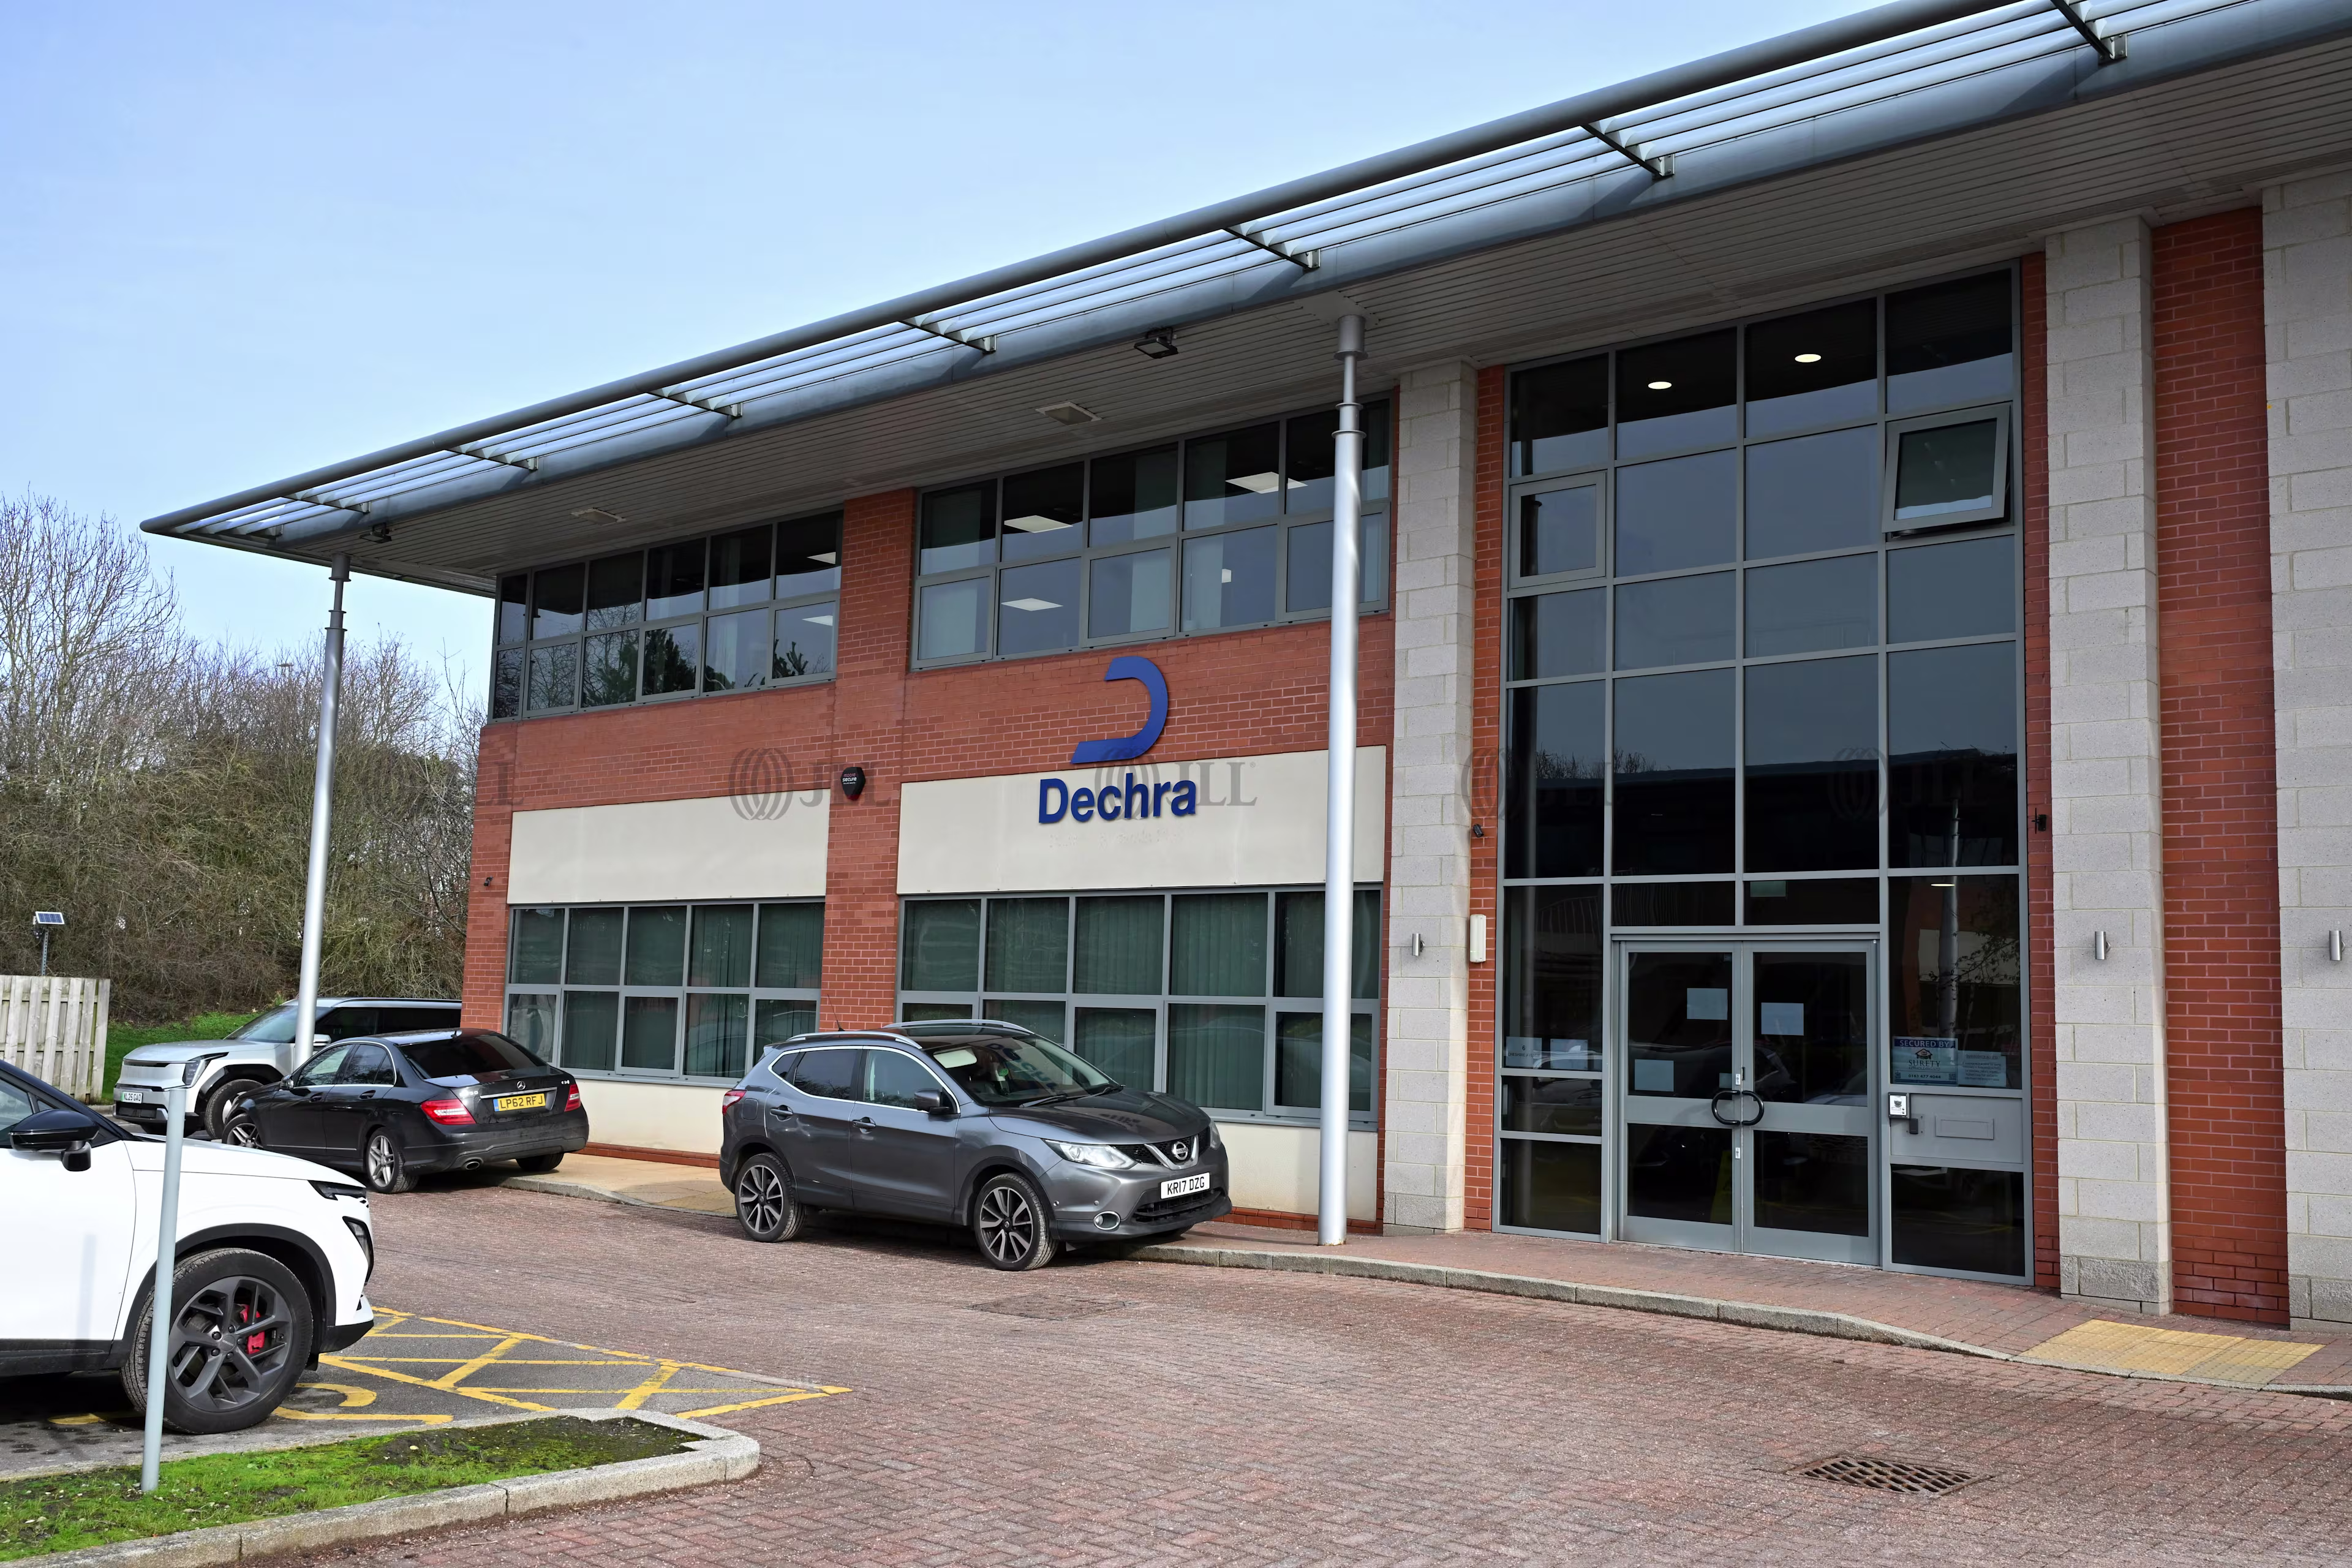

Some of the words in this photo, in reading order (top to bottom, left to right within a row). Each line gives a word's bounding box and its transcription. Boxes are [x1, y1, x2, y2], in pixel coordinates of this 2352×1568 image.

[1039, 772, 1196, 824] Dechra
[500, 1098, 524, 1109] LP62
[1167, 1180, 1187, 1196] KR17
[1189, 1176, 1205, 1191] DZG
